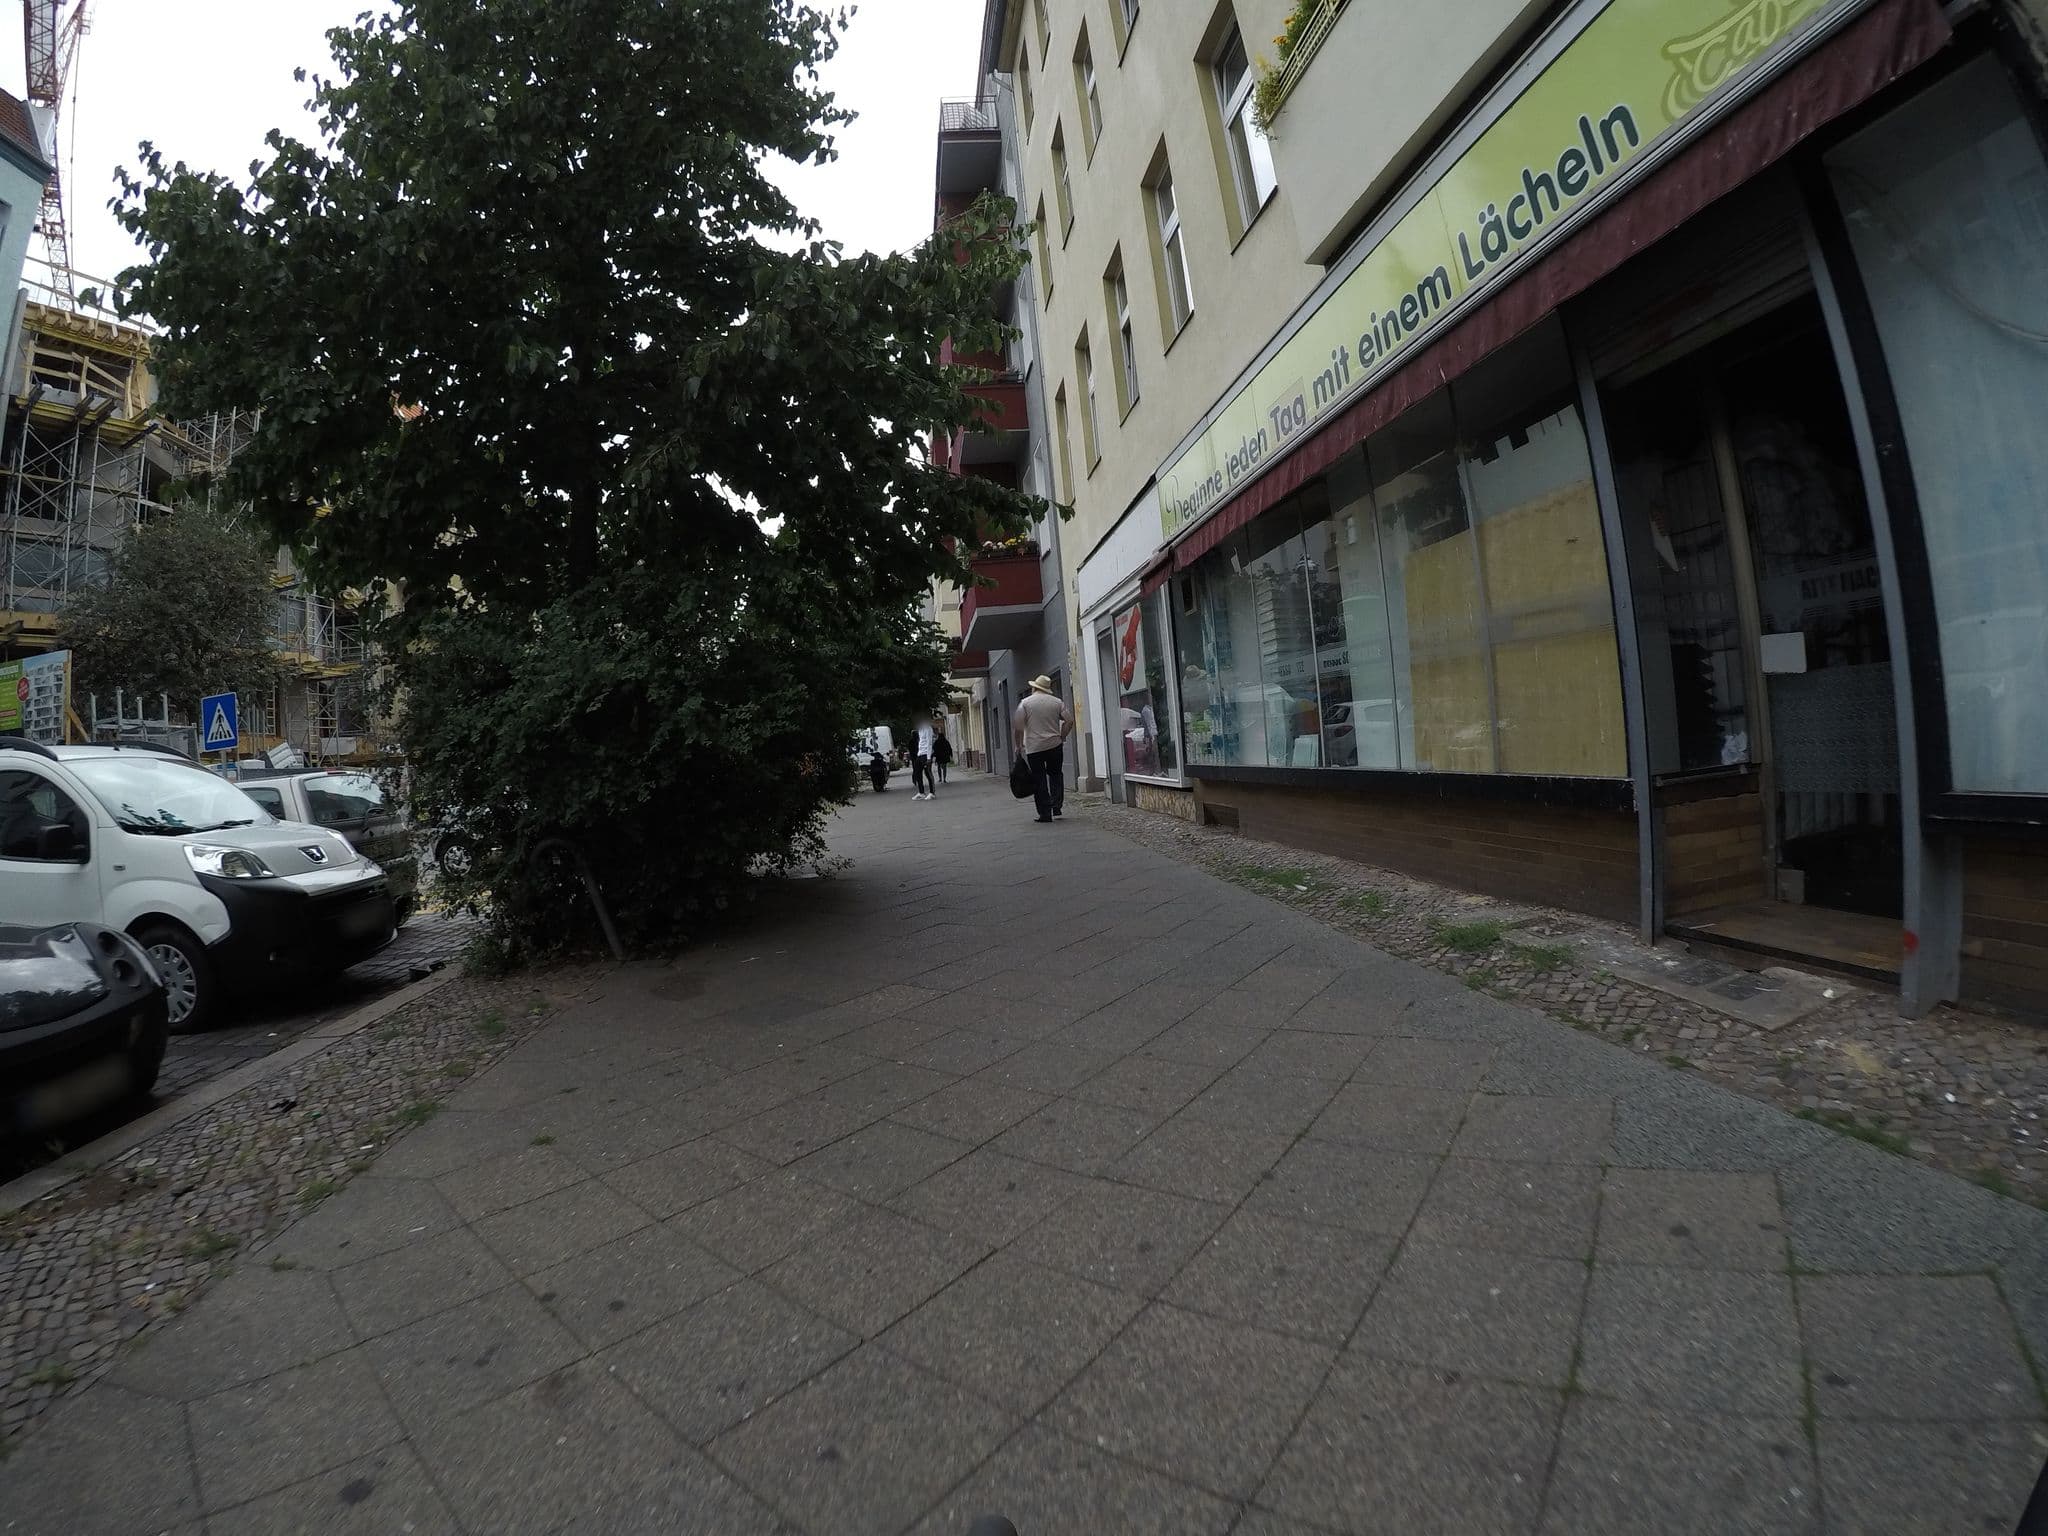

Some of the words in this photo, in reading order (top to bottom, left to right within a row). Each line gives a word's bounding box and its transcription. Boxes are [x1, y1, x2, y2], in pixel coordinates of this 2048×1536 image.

[1224, 426, 1268, 487] jeden
[1269, 393, 1307, 442] Tag
[1312, 344, 1350, 410] mit
[1358, 265, 1452, 369] einem
[1457, 104, 1640, 281] Lächeln
